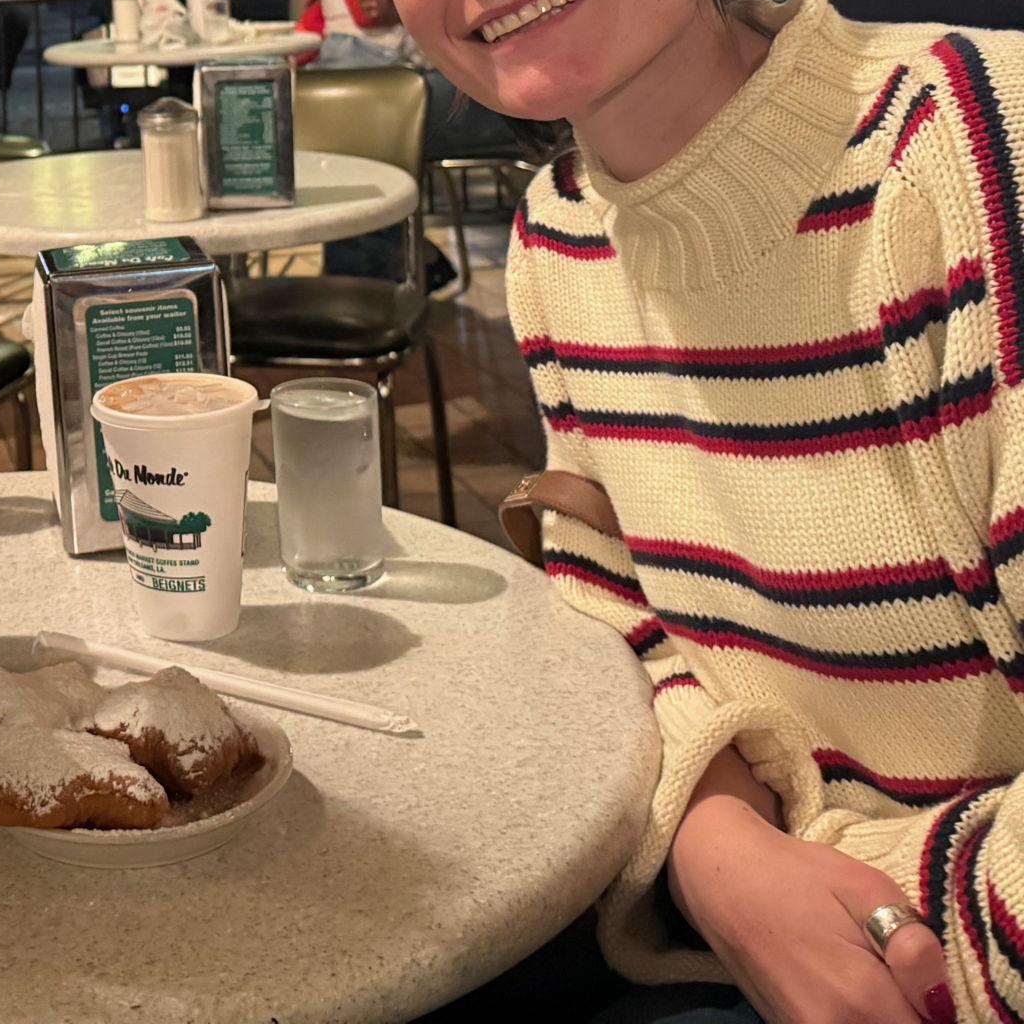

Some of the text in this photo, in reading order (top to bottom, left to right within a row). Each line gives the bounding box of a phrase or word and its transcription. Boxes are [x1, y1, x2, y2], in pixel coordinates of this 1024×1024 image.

[100, 308, 123, 316] Select
[125, 306, 155, 314] souvenir
[92, 317, 125, 325] Available
[114, 459, 132, 481] Du
[156, 558, 178, 567] COFFEE
[152, 577, 206, 591] BEIGNETS
